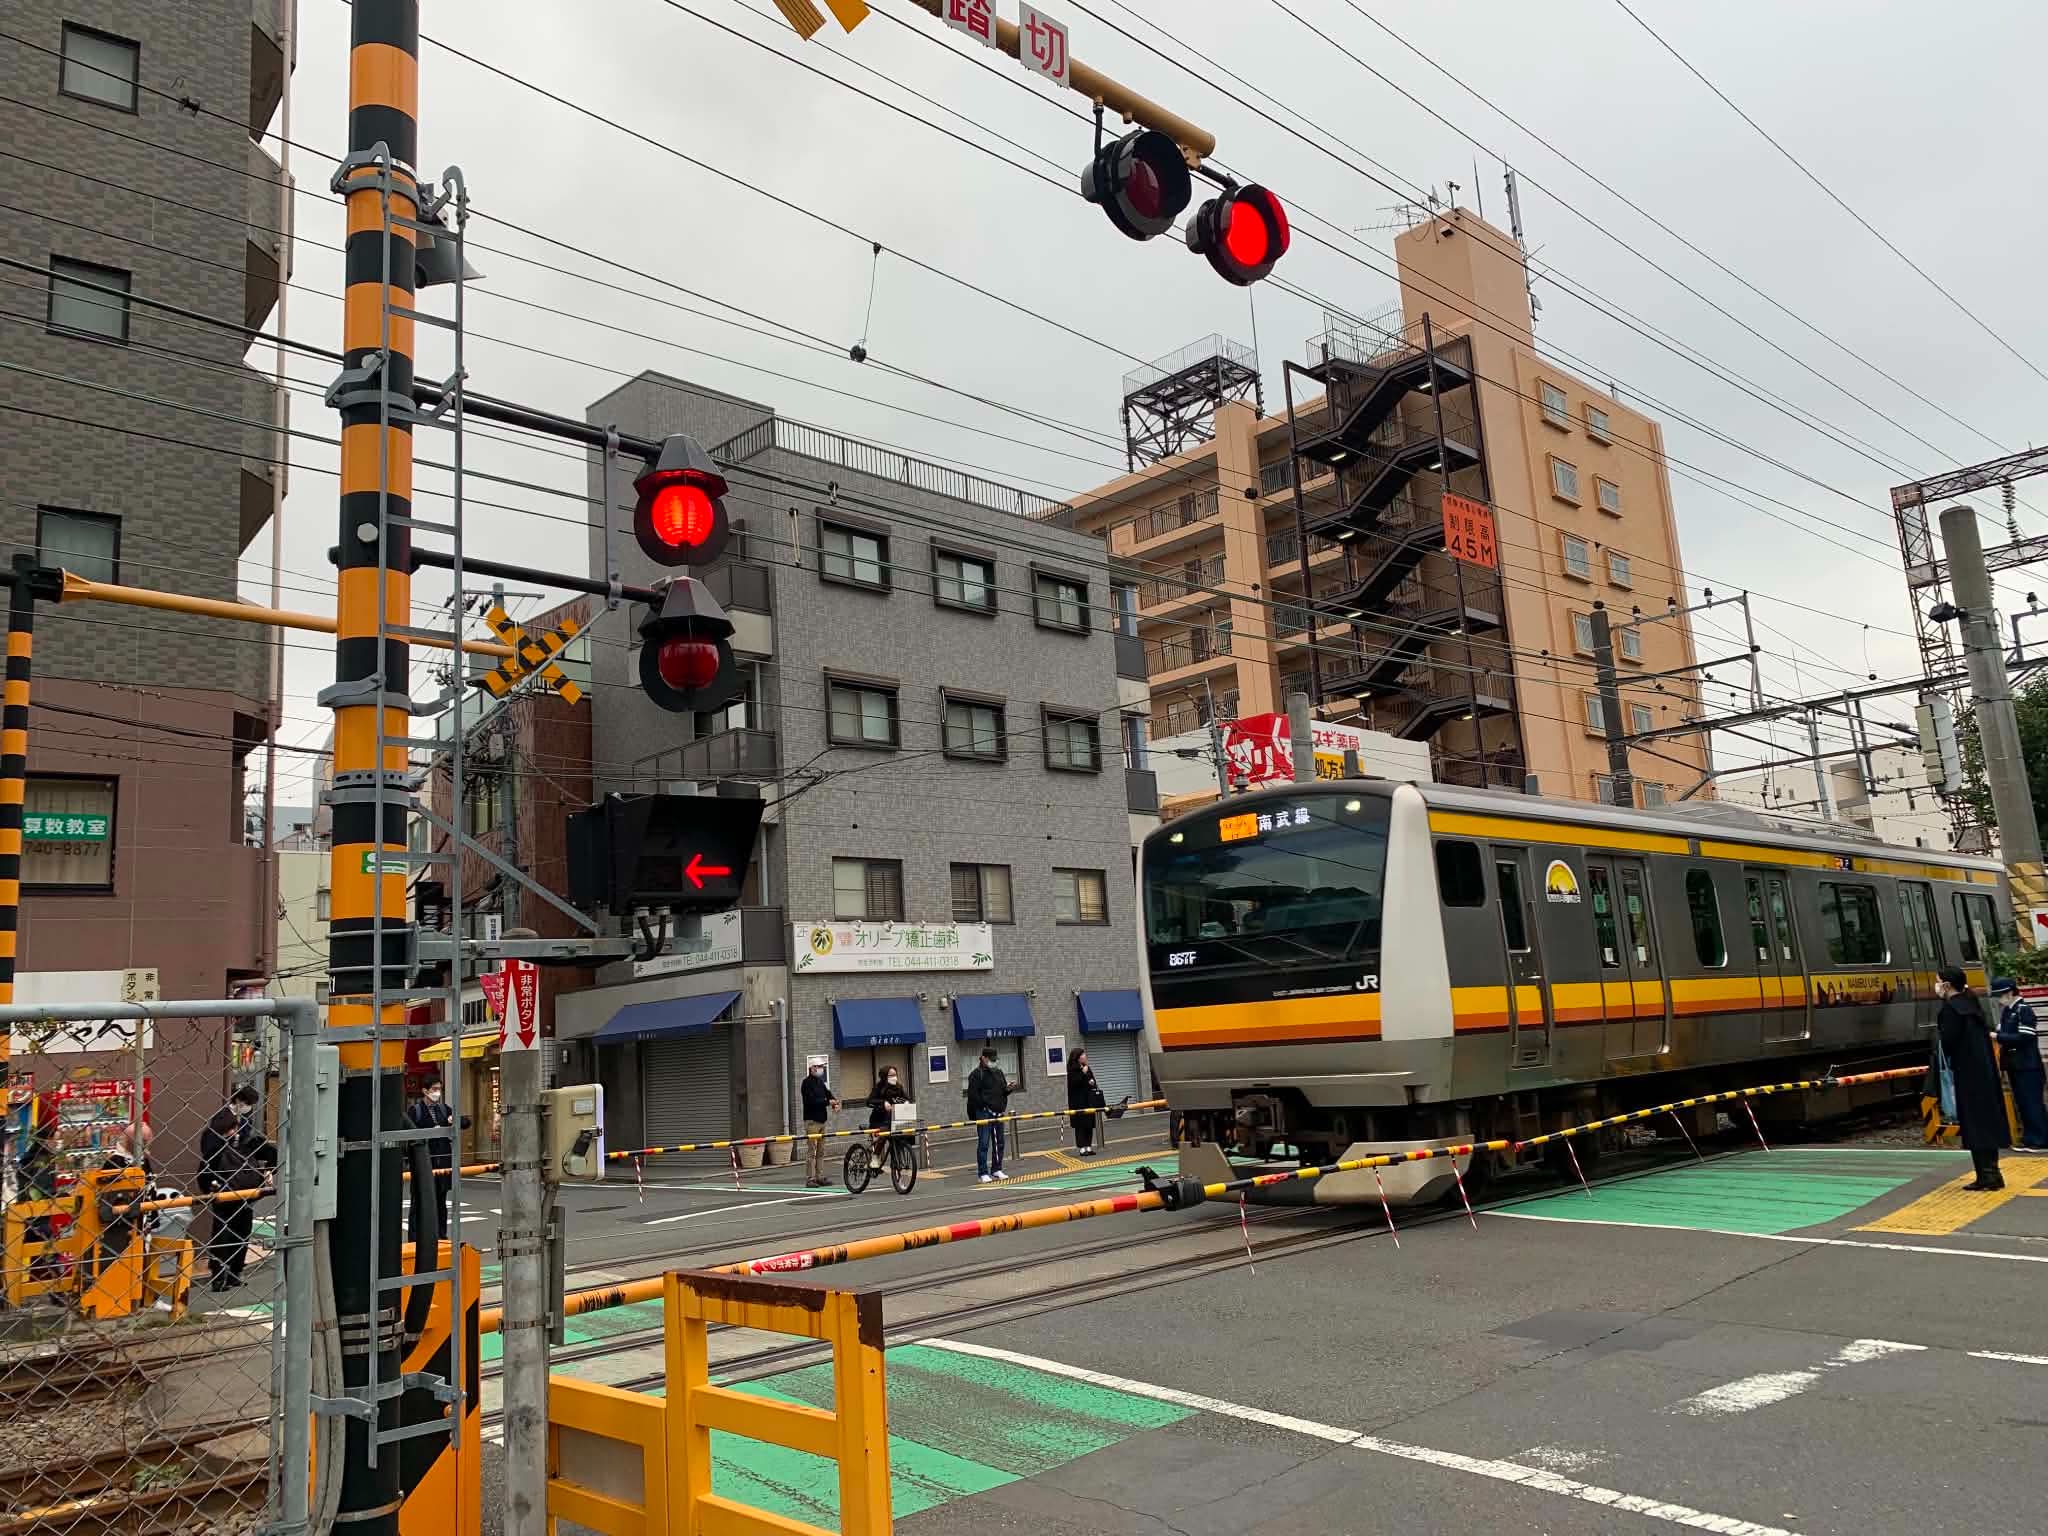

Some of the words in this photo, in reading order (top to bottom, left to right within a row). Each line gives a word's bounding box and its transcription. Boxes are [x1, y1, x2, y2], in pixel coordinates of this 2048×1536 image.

[24, 817, 107, 835] 算数教室
[1356, 974, 1378, 990] JR
[520, 974, 533, 1032] 非常ボタン
